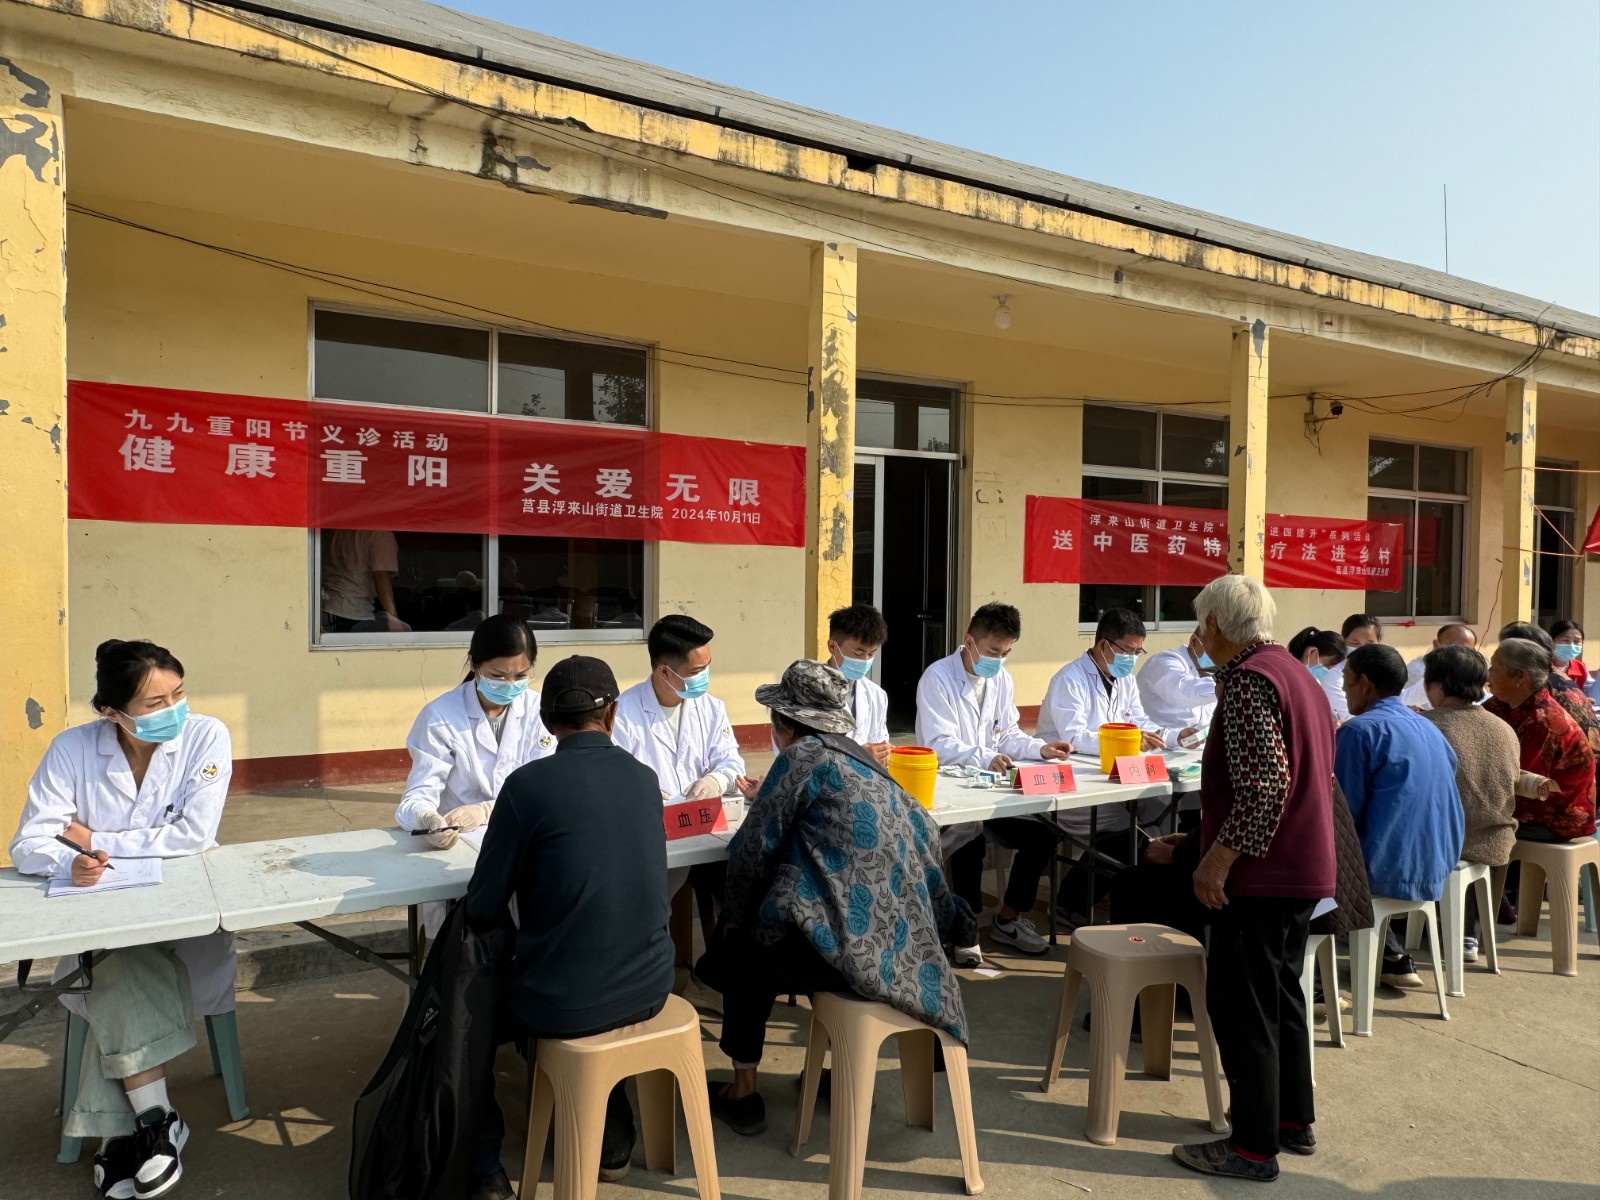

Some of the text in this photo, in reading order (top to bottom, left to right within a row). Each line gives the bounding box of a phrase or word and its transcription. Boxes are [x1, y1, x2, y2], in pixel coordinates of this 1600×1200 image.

[124, 409, 449, 451] 九九重阳节义诊活动
[119, 434, 761, 506] 健康重阳 关爱无限
[522, 498, 761, 525] 莒县浮来山街道卫生院 2024年10月11日
[1129, 763, 1156, 777] 内科
[678, 808, 712, 828] 血压
